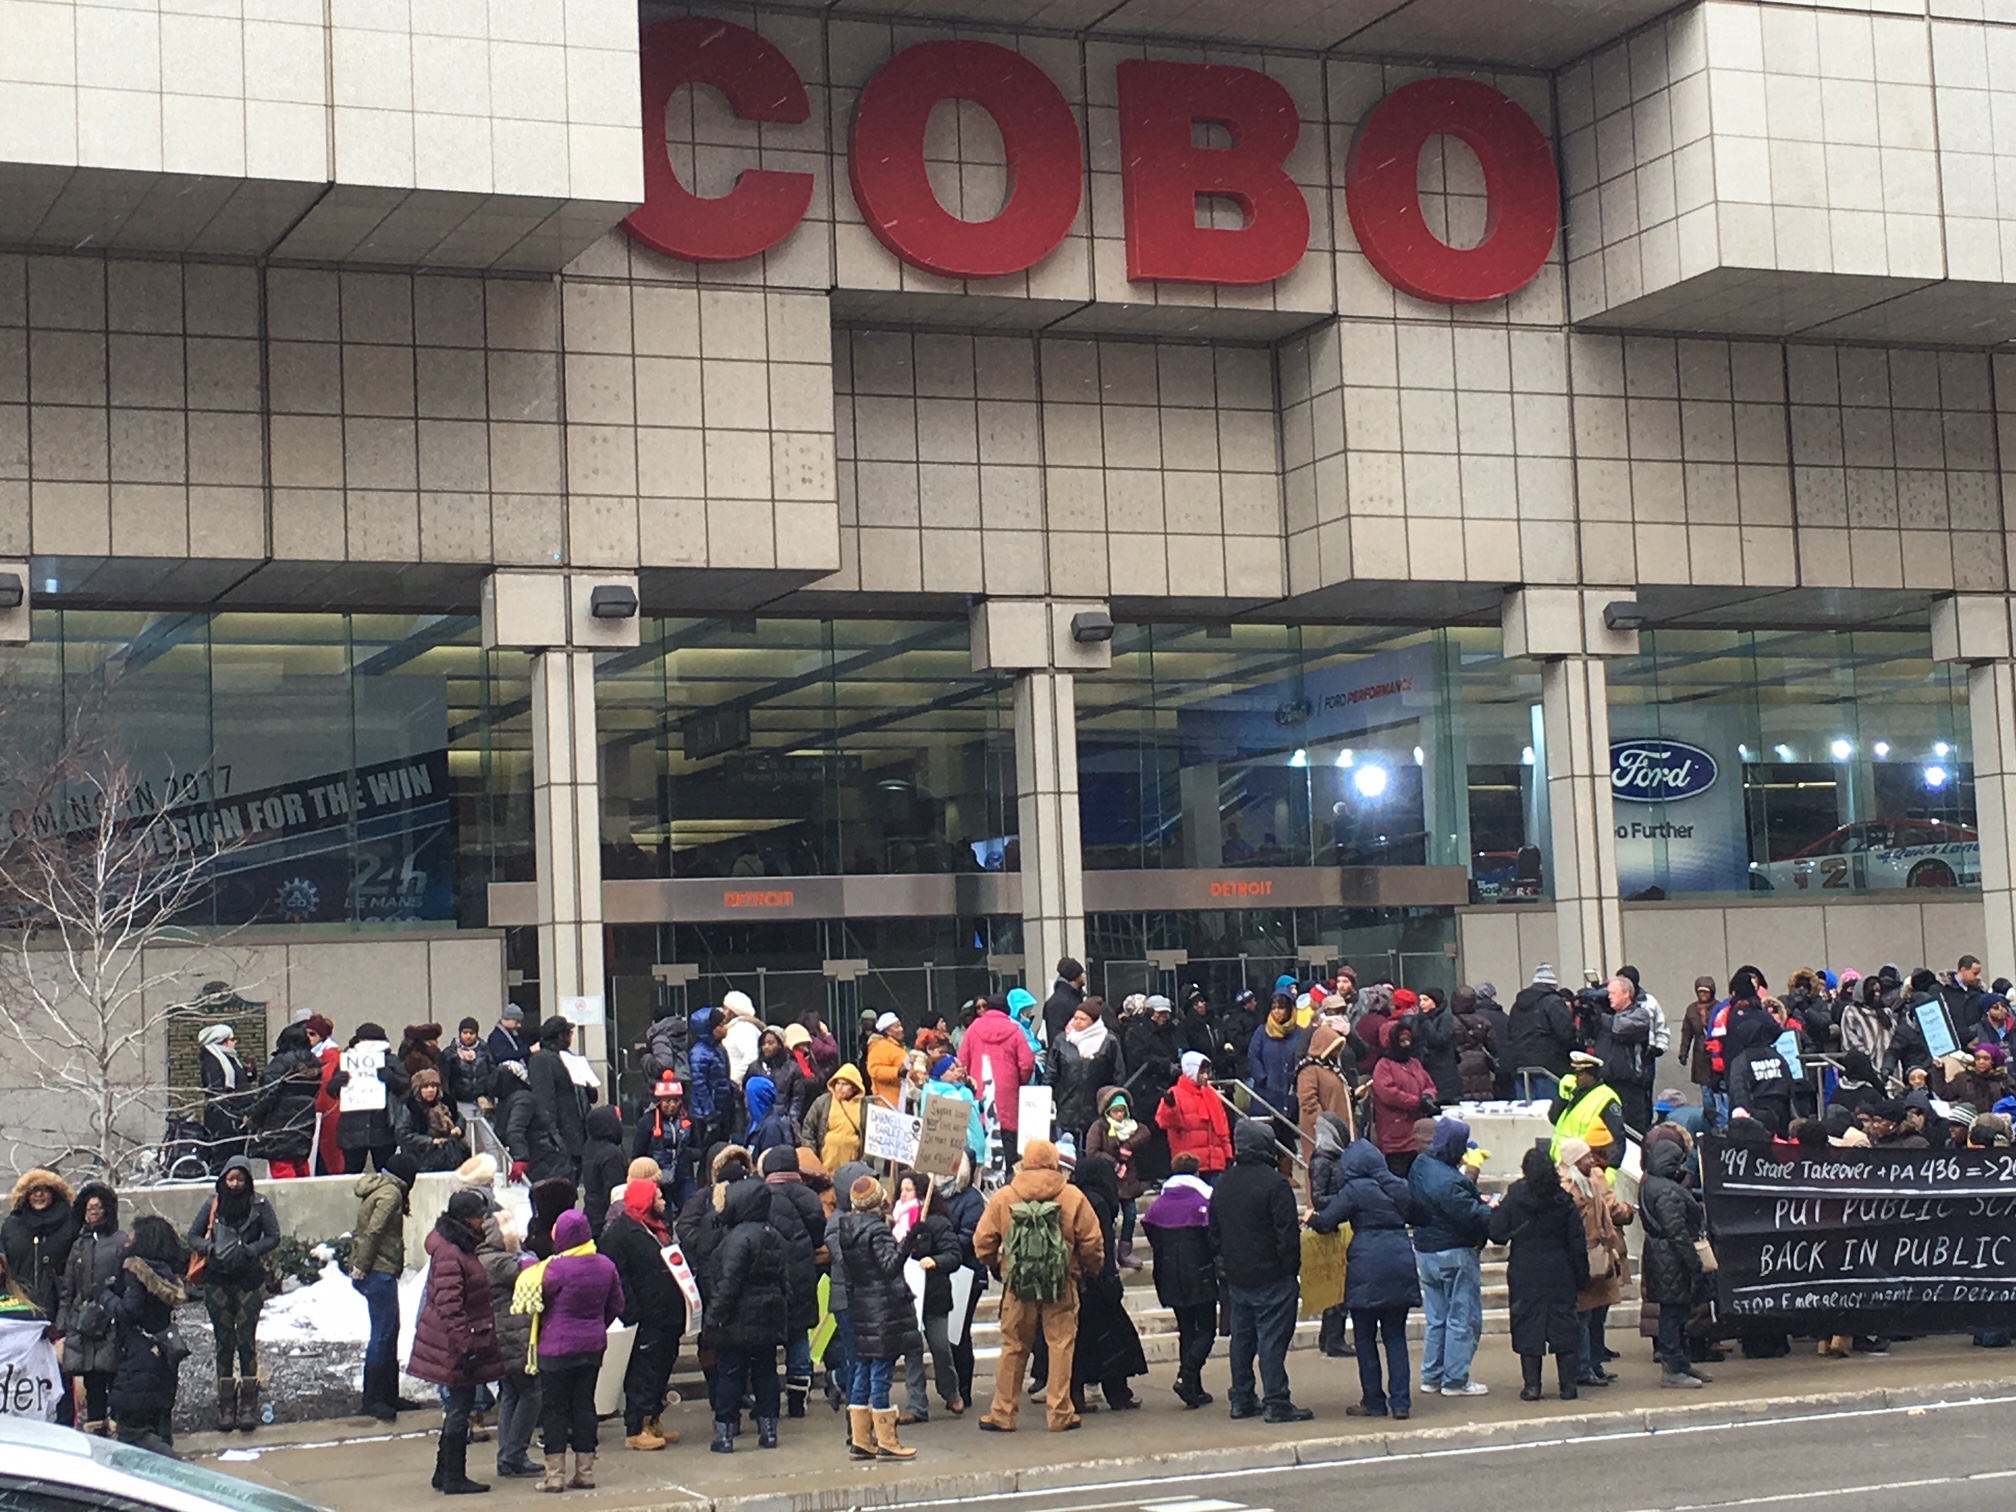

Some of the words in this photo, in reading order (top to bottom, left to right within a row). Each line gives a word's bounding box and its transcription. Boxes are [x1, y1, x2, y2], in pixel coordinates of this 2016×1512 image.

[621, 15, 1562, 305] COBO
[1347, 677, 1413, 705] PERFORMANCE
[1611, 749, 1692, 788] Ford
[165, 764, 232, 804] 2017
[247, 793, 307, 833] FOR
[307, 778, 367, 819] THE
[367, 763, 433, 806] WIN
[1614, 825, 1628, 838] o
[1631, 821, 1694, 839] Further
[369, 896, 423, 909] MANS
[724, 890, 793, 908] DETROIT
[1209, 880, 1272, 897] DETROIT
[347, 1055, 375, 1070] NO
[868, 1143, 878, 1153] TO
[1720, 1148, 1748, 1177] '99
[1754, 1157, 1795, 1179] State
[1801, 1160, 1877, 1181] Takeover
[1919, 1158, 1960, 1184] 436
[1842, 1198, 1954, 1222] PUBLIC
[1760, 1239, 1828, 1277] BACK
[1839, 1238, 1880, 1271] IN
[1894, 1235, 2011, 1269] PUBLIC
[1732, 1297, 1775, 1315] STOP
[1922, 1283, 1944, 1302] of
